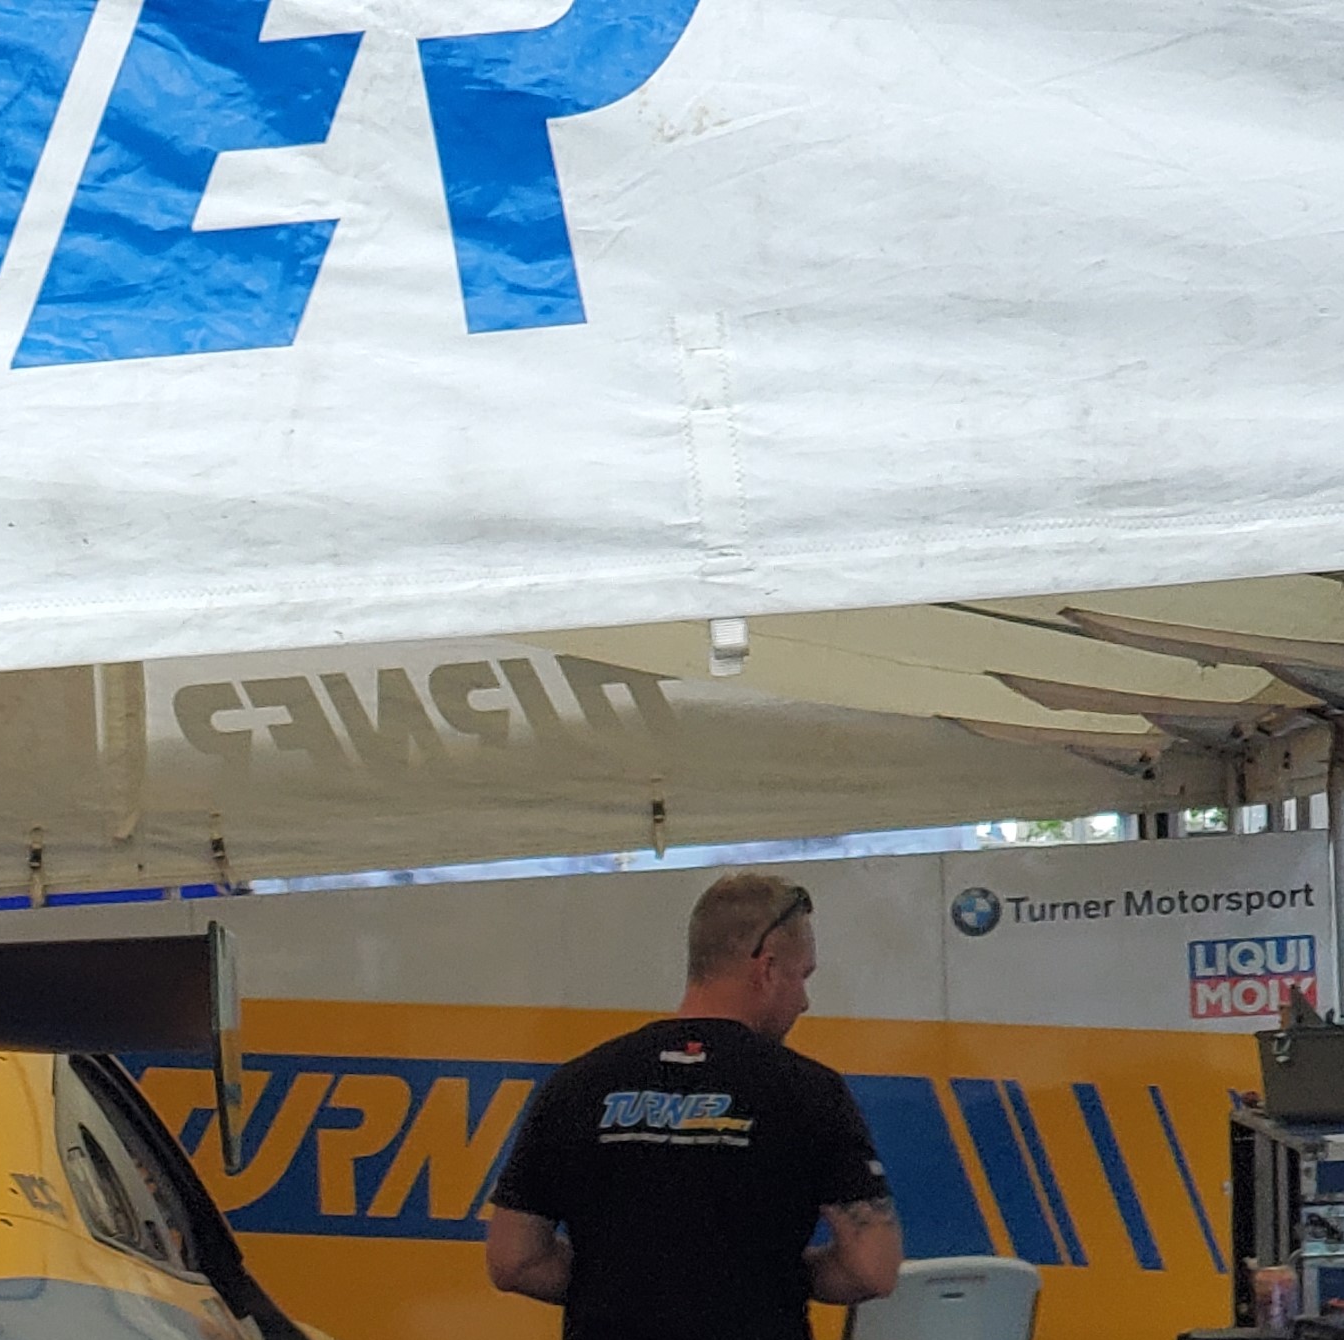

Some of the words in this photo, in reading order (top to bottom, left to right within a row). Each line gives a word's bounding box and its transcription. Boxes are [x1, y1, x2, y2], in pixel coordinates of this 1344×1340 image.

[1005, 896, 1117, 924] Turner
[1123, 882, 1316, 917] Motorsport
[1194, 939, 1313, 977] LIQUI
[599, 1090, 733, 1129] TURNER
[139, 1067, 535, 1221] TURN
